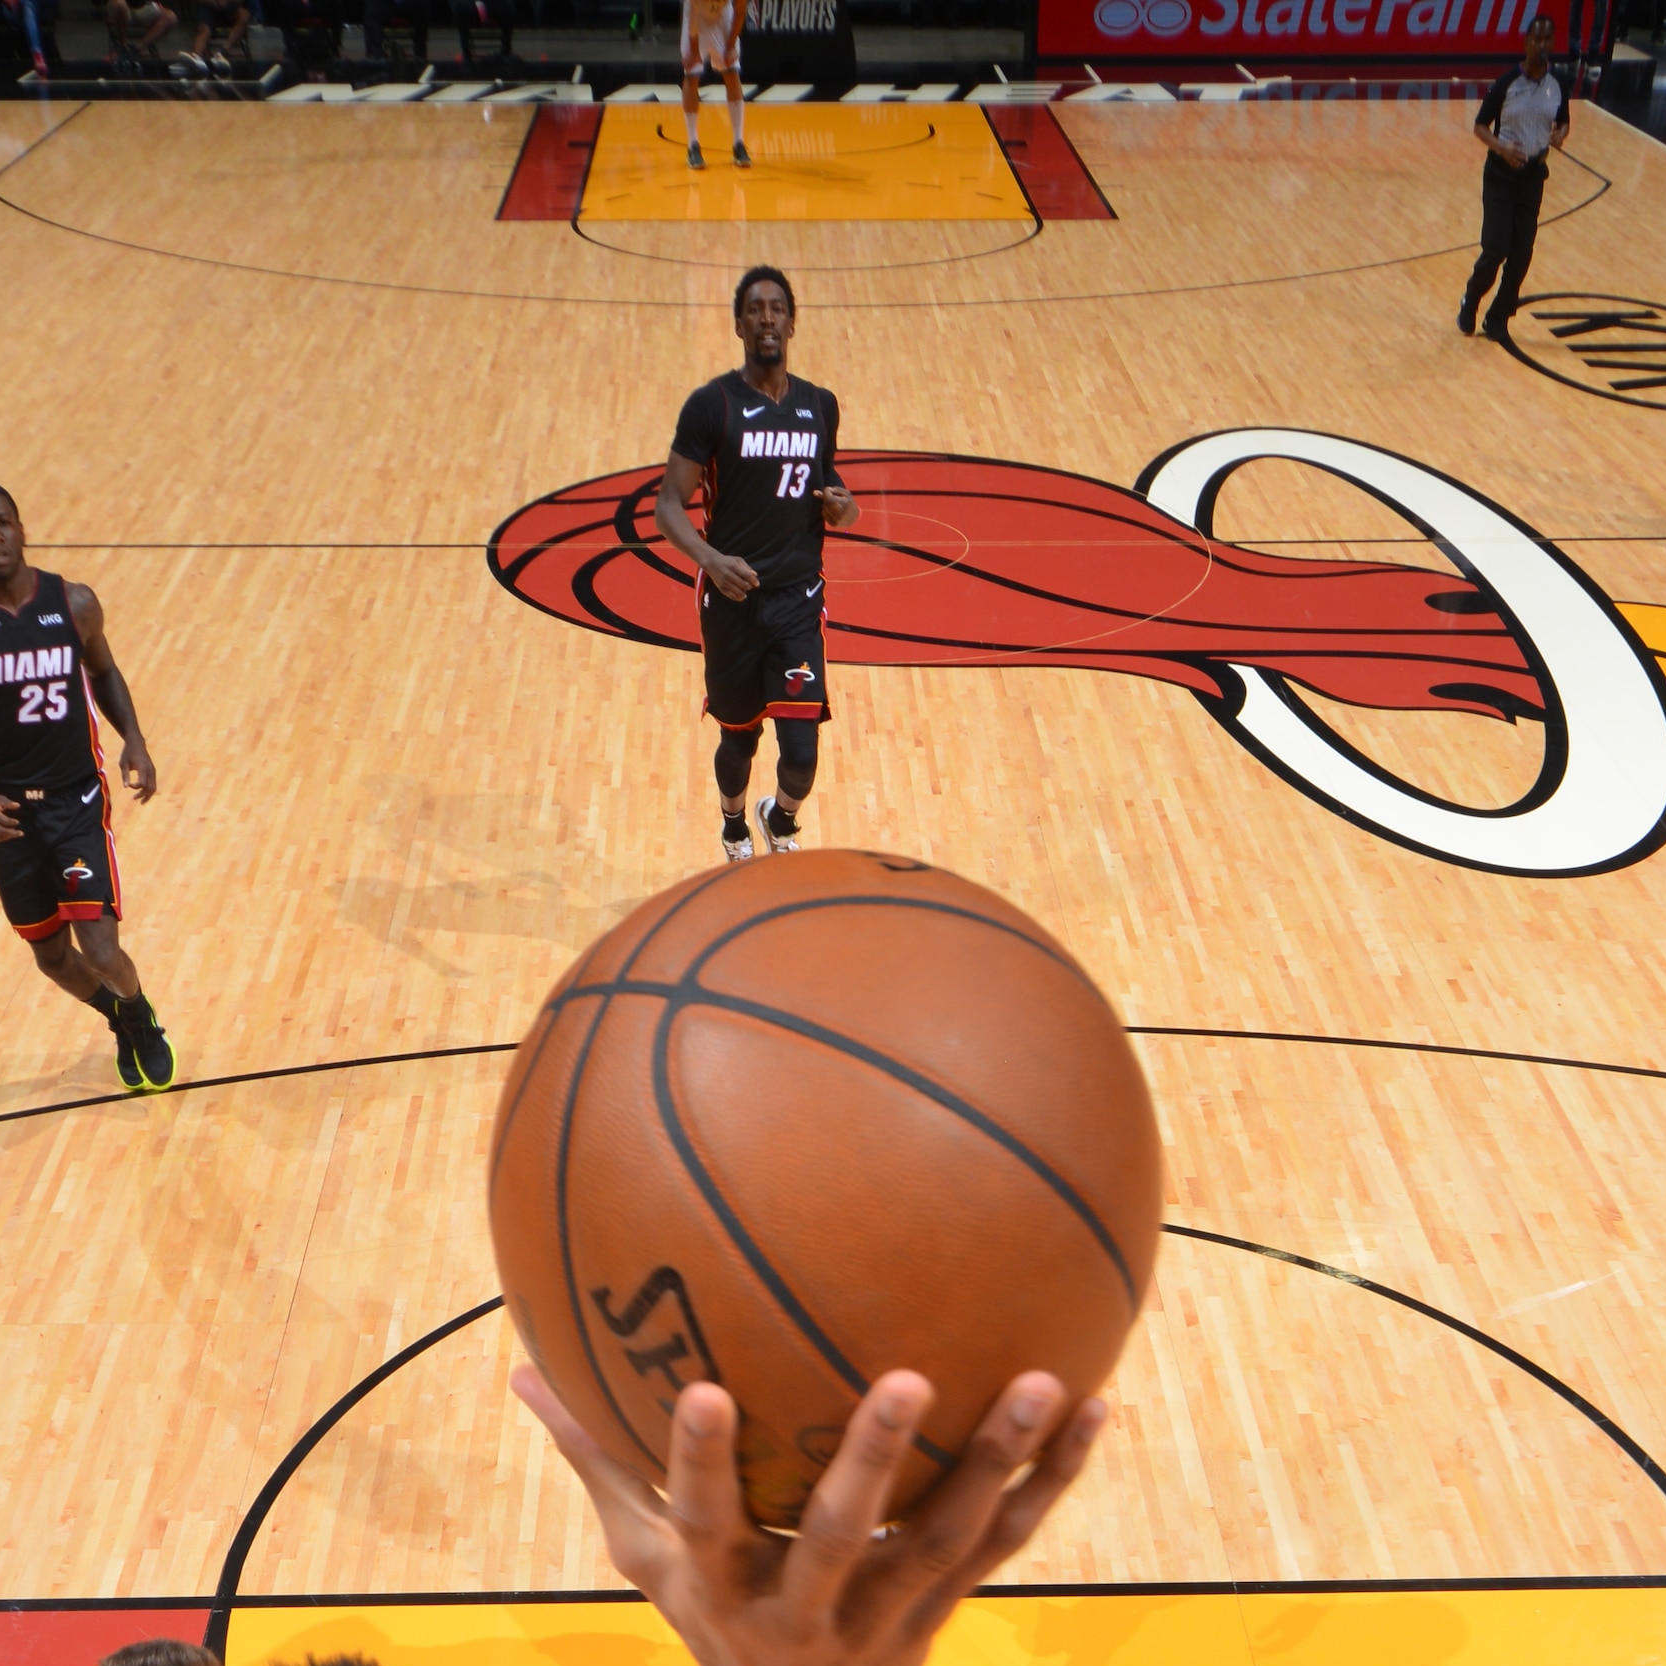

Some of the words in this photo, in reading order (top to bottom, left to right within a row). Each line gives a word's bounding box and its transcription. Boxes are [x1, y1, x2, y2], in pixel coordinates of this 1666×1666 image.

[740, 431, 818, 459] MIAMI
[776, 463, 812, 499] 13
[38, 613, 64, 625] UKG
[18, 682, 69, 723] 25
